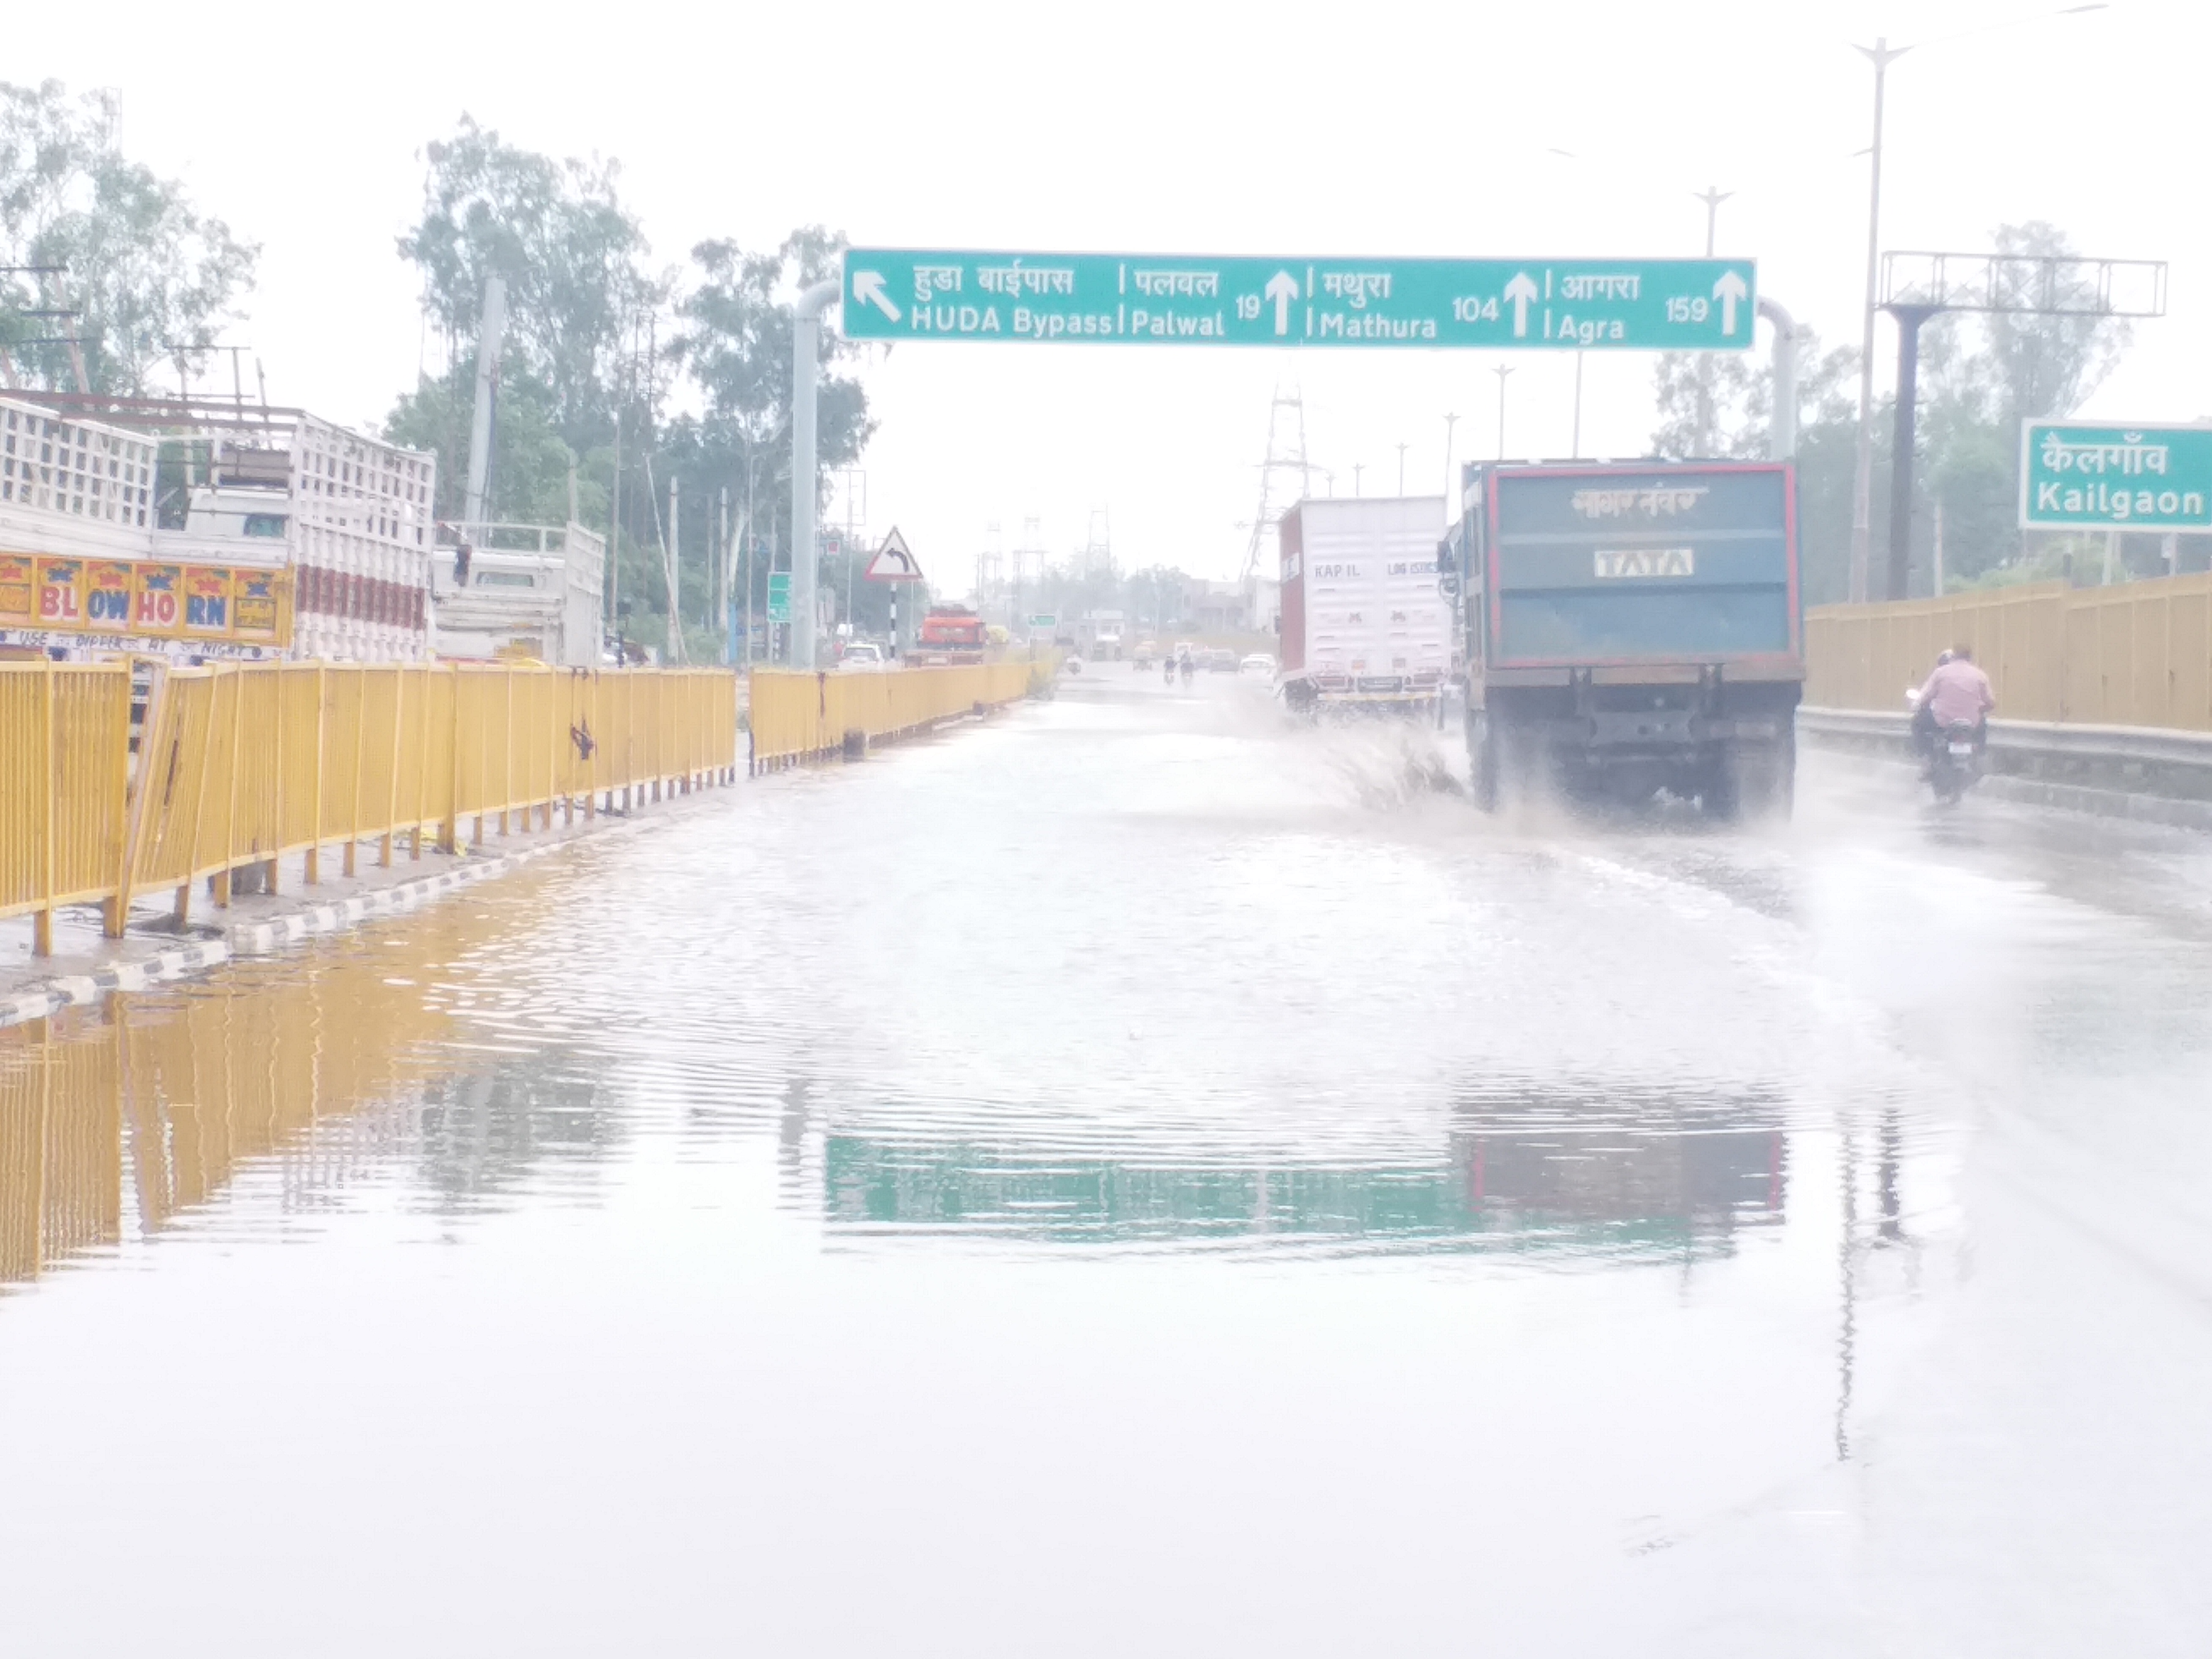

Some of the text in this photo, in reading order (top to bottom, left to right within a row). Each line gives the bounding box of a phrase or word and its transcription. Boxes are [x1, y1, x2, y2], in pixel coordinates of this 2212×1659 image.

[913, 259, 1074, 302] हुडा बाईपास
[1134, 270, 1219, 298] पलवल
[1322, 272, 1393, 309] मथुरा
[1561, 274, 1641, 300] आगरा
[1236, 294, 1262, 320] 19
[1452, 297, 1500, 322] 104
[1666, 296, 1710, 324] 159
[912, 305, 1112, 338] HUDA Bypass
[1132, 310, 1225, 337] Palwal
[1320, 312, 1437, 339] Mathura
[1558, 314, 1625, 344] Agra
[2040, 431, 2169, 474] कैलगाँव
[2038, 481, 2204, 519] Kailgaon
[1595, 550, 1693, 576] TATA
[20, 630, 48, 646] USE
